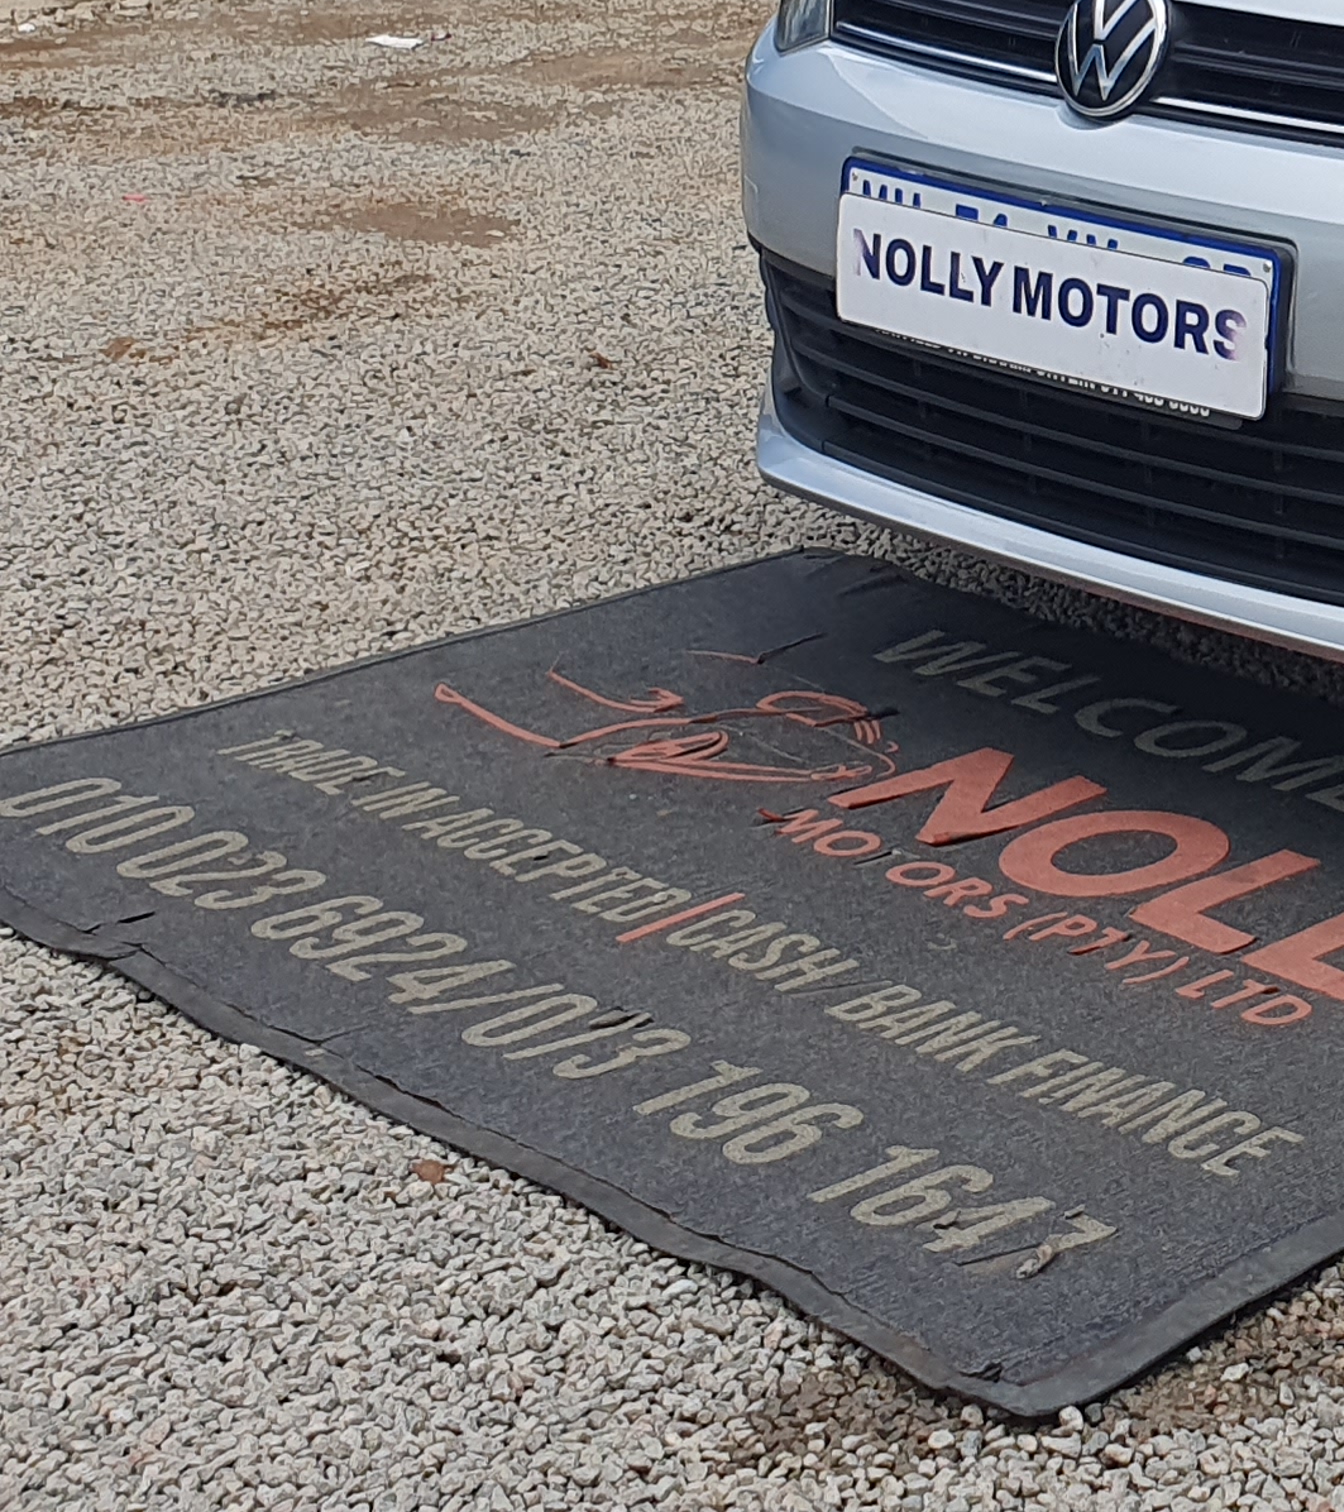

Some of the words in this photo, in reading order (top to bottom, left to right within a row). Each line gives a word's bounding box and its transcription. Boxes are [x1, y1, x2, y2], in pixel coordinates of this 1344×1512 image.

[853, 227, 1004, 308] NOLLY
[1012, 265, 1248, 361] MOTORS
[0, 777, 196, 854] 010
[116, 830, 327, 910] 023
[632, 1058, 865, 1165] 196
[806, 1144, 1118, 1279] 1647
[217, 729, 406, 796] TRADE
[351, 781, 461, 820] IN
[986, 1048, 1305, 1178] FINANCE
[1002, 912, 1190, 986] (PTY)
[1174, 969, 1313, 1026] LTD
